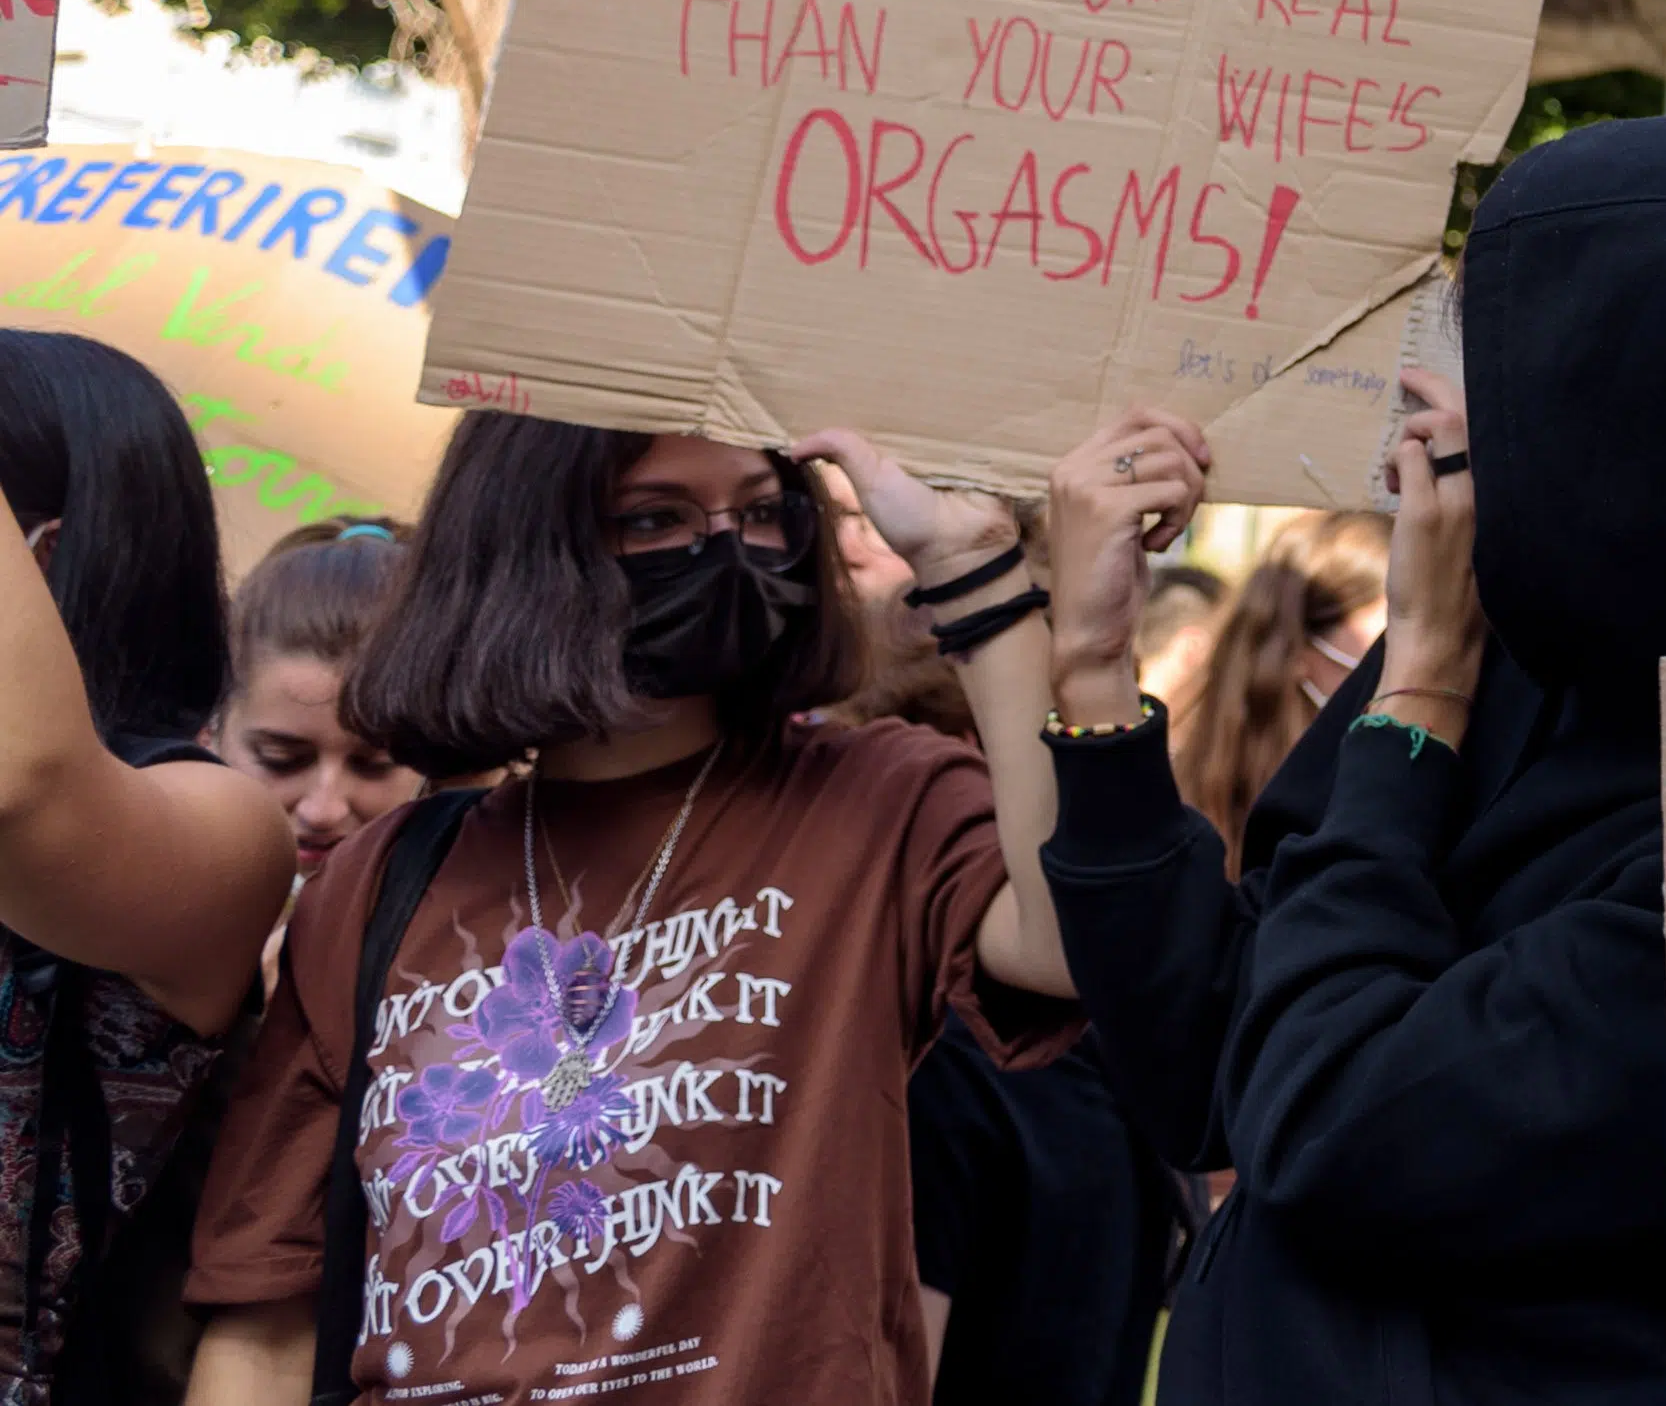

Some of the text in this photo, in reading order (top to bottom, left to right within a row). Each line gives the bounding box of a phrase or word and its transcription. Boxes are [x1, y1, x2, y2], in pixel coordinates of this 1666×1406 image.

[964, 15, 1131, 118] YOUR
[1217, 53, 1443, 162] WIFE'S
[0, 155, 451, 307] PREFERIREI
[774, 108, 1301, 320] ORGASMS!
[735, 1069, 787, 1124] IT
[731, 1170, 782, 1228] IT
[530, 1388, 546, 1401] TO
[632, 1372, 648, 1385] TO
[650, 1367, 674, 1382] THE
